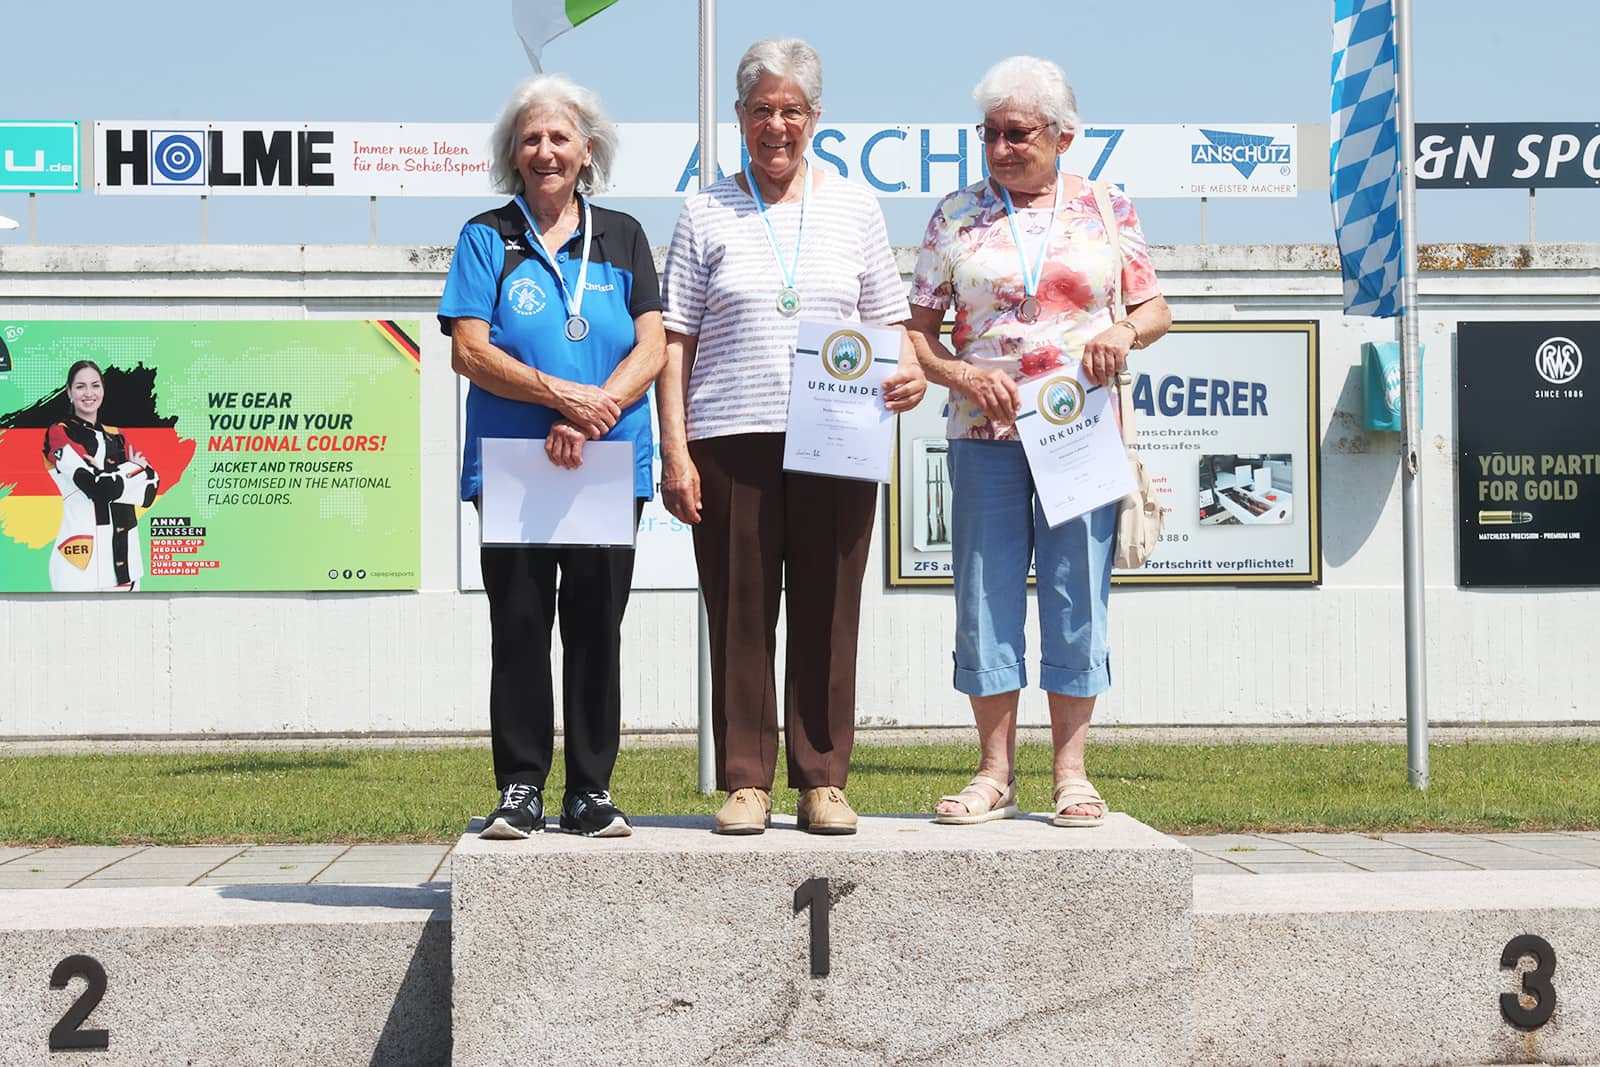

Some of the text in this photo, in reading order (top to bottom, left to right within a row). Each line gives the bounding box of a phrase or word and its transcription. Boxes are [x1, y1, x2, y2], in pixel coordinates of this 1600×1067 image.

[353, 141, 470, 155] Immer neue Ideen
[353, 157, 490, 176] für den Schießsport!
[675, 128, 1125, 192] ASCHZ
[1191, 184, 1292, 193] DIE MEISTER MACHER
[1541, 343, 1577, 380] RWS
[808, 380, 879, 397] URKUNDE
[1132, 373, 1269, 417] AGERER
[1535, 390, 1560, 398] SINCE
[208, 392, 292, 408] WE GEAR
[209, 414, 353, 430] YOU UP IN YOUR
[1039, 414, 1101, 447] URKUNDE
[207, 435, 388, 452] NATIONAL COLORS!
[209, 461, 353, 473] JACKET AND TROUSERS
[1479, 454, 1535, 476] YOUR
[207, 477, 392, 489] CUSTOMISED IN THE NATIONAL
[1479, 480, 1578, 501] FOR GOLD
[207, 493, 293, 505] FLAG COLORS.
[152, 518, 185, 526] ANNA
[151, 528, 203, 536] JANSSEN
[1167, 534, 1179, 542] 88
[1183, 534, 1189, 542] 0
[64, 545, 89, 555] GER
[914, 561, 939, 571] ZFS
[1144, 559, 1294, 570] Fortschritt verpflichtet!
[794, 877, 829, 978] 1
[1500, 934, 1556, 1032] 3
[49, 954, 109, 1051] 2
